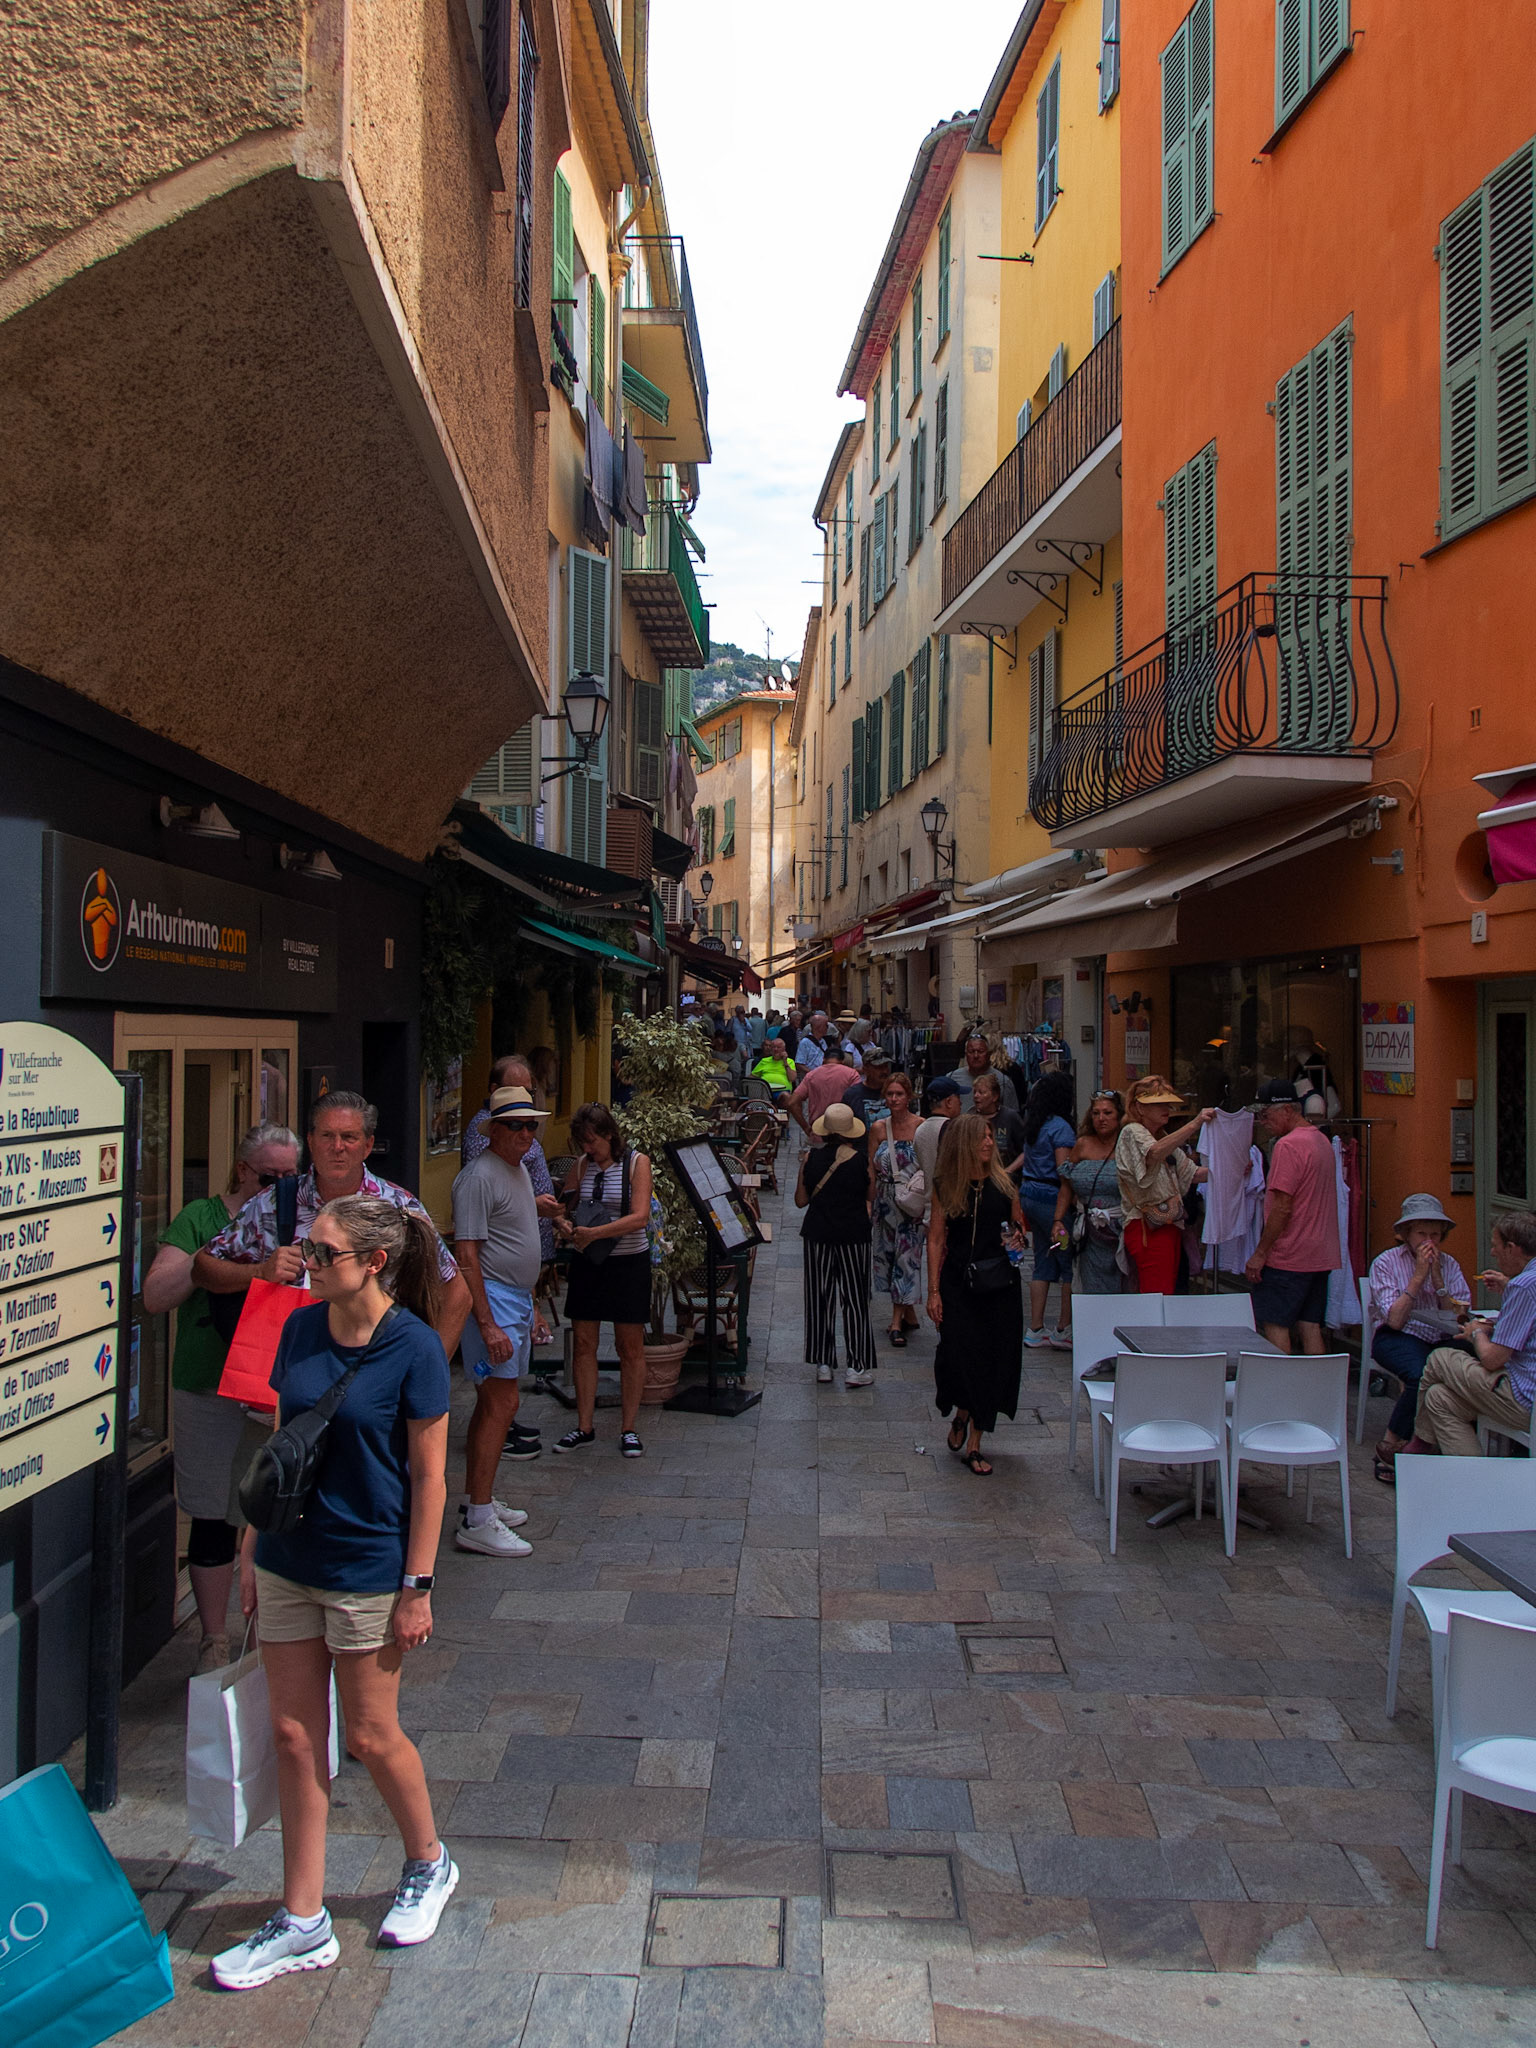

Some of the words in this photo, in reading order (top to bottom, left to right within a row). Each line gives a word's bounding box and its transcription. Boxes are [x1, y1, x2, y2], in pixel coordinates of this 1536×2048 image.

[126, 898, 247, 955] Arthurimmo.com
[1475, 915, 1482, 937] 2
[1365, 1031, 1410, 1059] PAPAYA
[9, 1051, 63, 1069] Villefranche
[8, 1073, 21, 1085] sur
[23, 1070, 39, 1084] Mer
[7, 1109, 18, 1131] la
[21, 1105, 79, 1133] République
[42, 1146, 81, 1171] Musées
[16, 1182, 26, 1205] C.
[38, 1176, 87, 1200] Museums
[18, 1218, 50, 1247] SNCF
[13, 1249, 55, 1278] Station
[5, 1292, 57, 1324] Maritime
[9, 1314, 61, 1353] Terminal
[3, 1376, 18, 1399] de
[21, 1358, 69, 1391] Tourisme
[24, 1392, 55, 1421] Office
